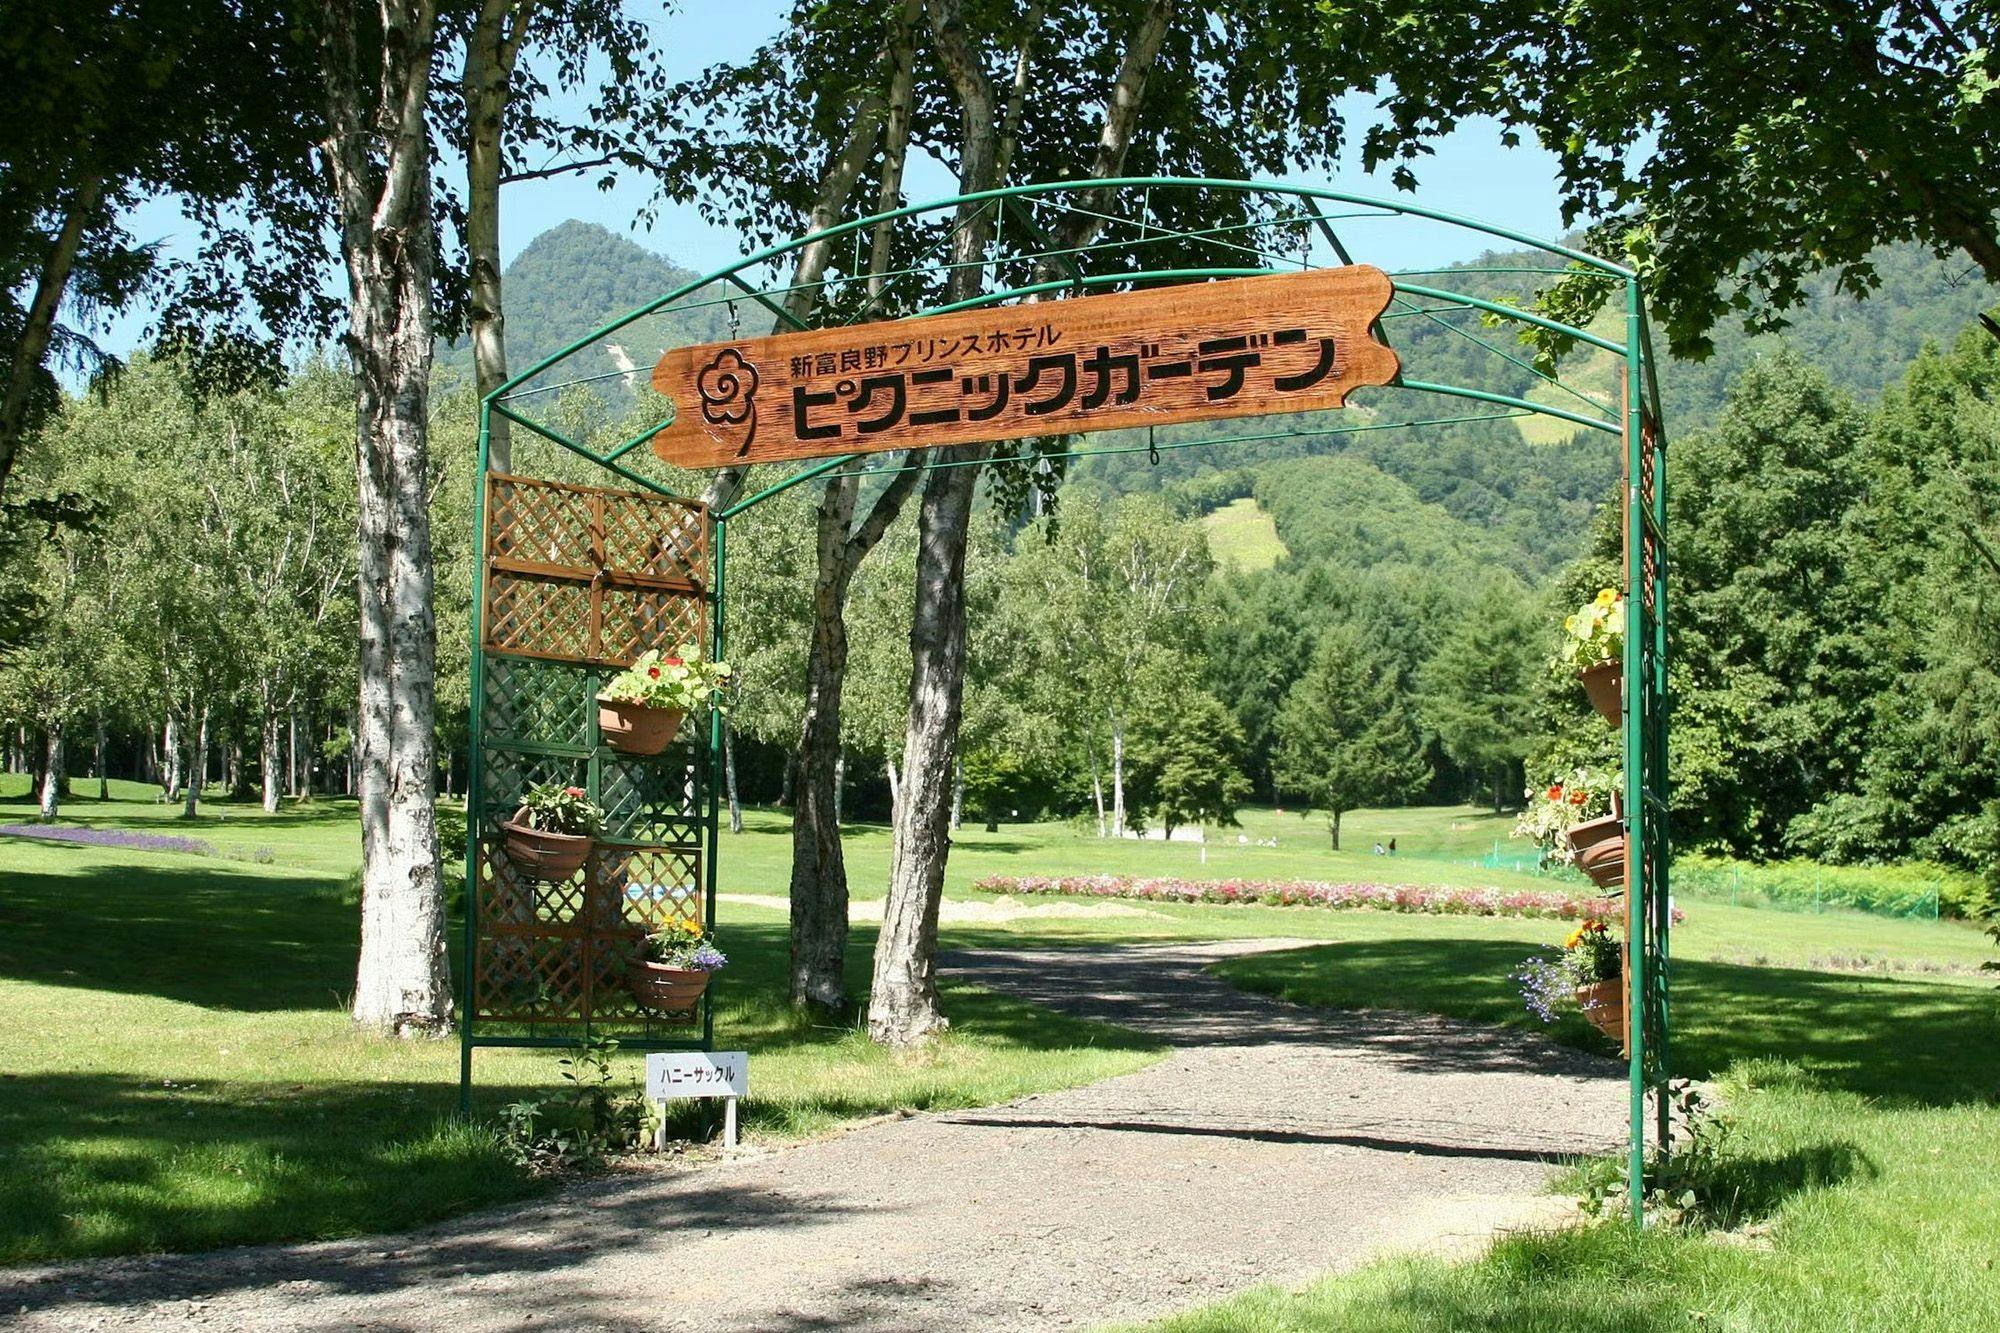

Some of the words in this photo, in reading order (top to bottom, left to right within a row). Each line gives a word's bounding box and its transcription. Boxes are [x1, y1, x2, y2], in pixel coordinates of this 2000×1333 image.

[792, 325, 1061, 378] 新富良野プリンスホテル
[793, 329, 1335, 440] ピクニックガーデン
[661, 1066, 735, 1083] ハニーサックル
